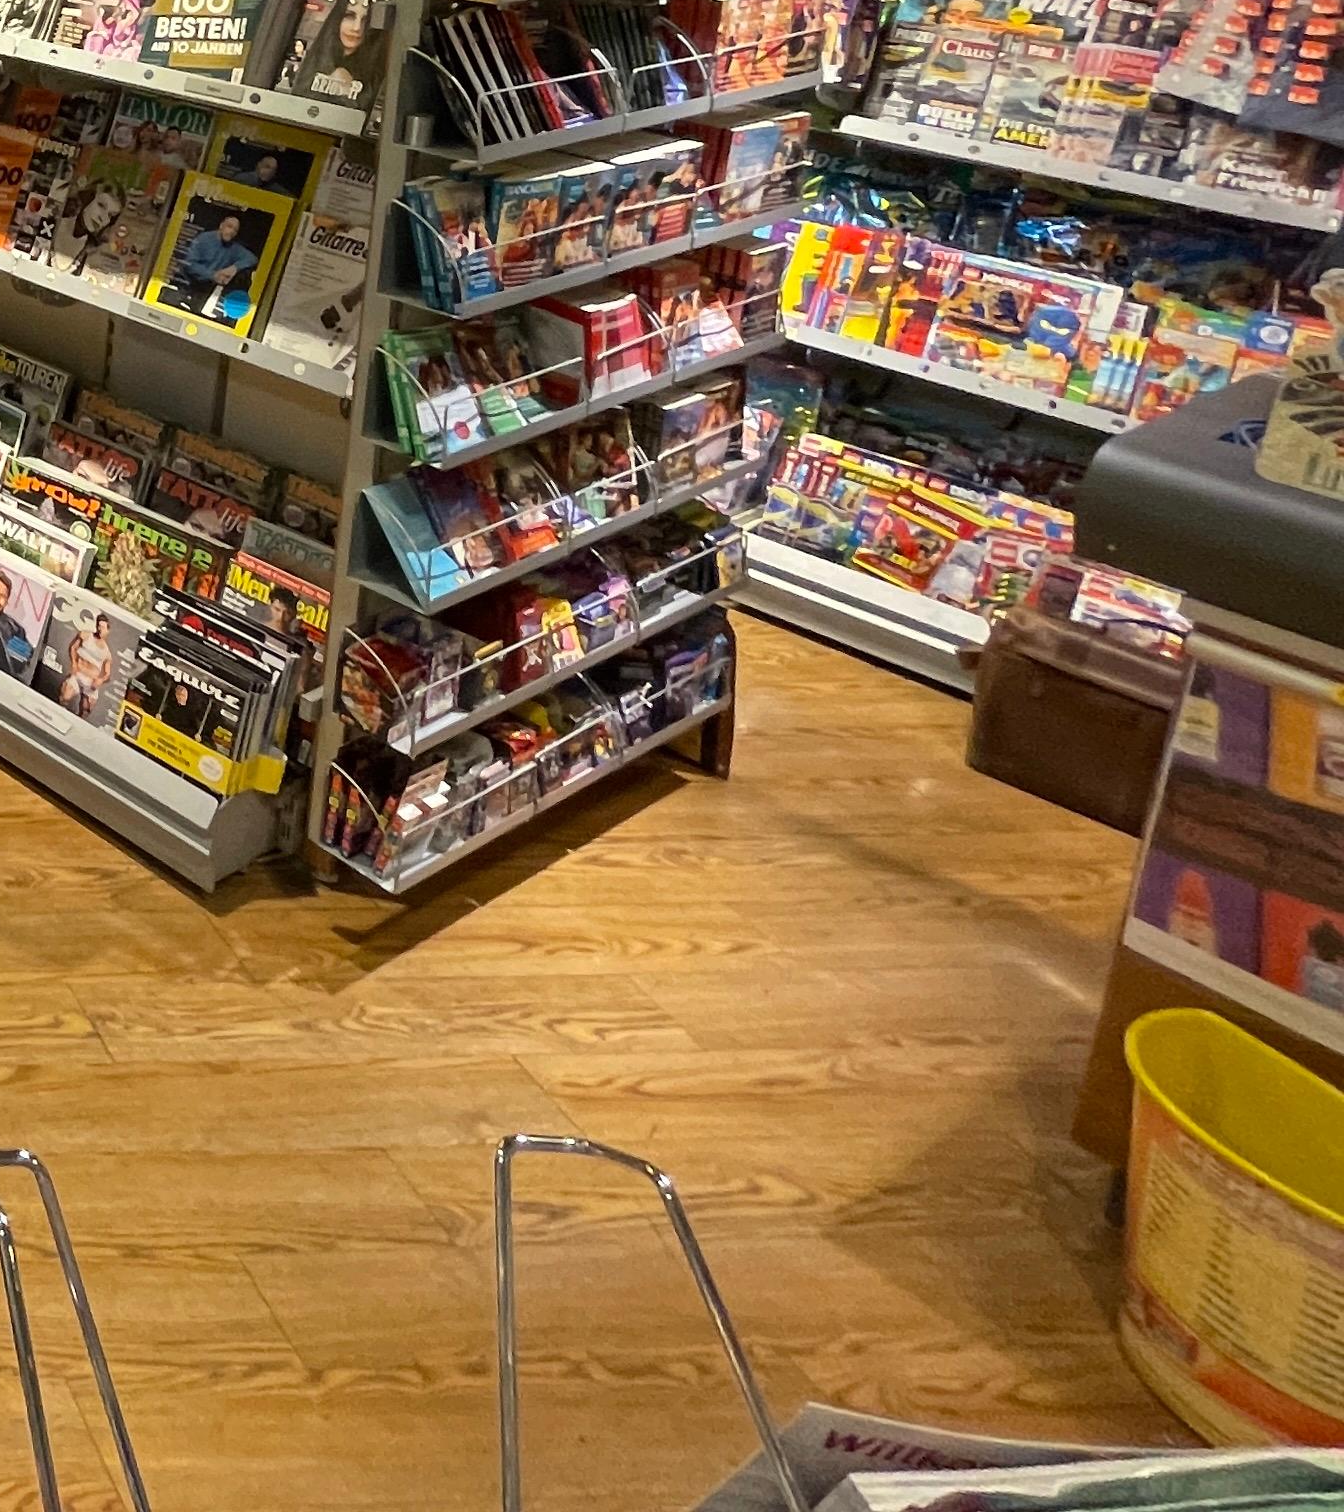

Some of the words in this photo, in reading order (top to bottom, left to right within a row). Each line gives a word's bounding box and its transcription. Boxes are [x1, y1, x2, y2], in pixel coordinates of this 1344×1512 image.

[155, 17, 248, 41] BESTEN!
[190, 43, 243, 56] JAHREN
[125, 97, 208, 132] TAYLOR
[138, 646, 240, 710] Esquire
